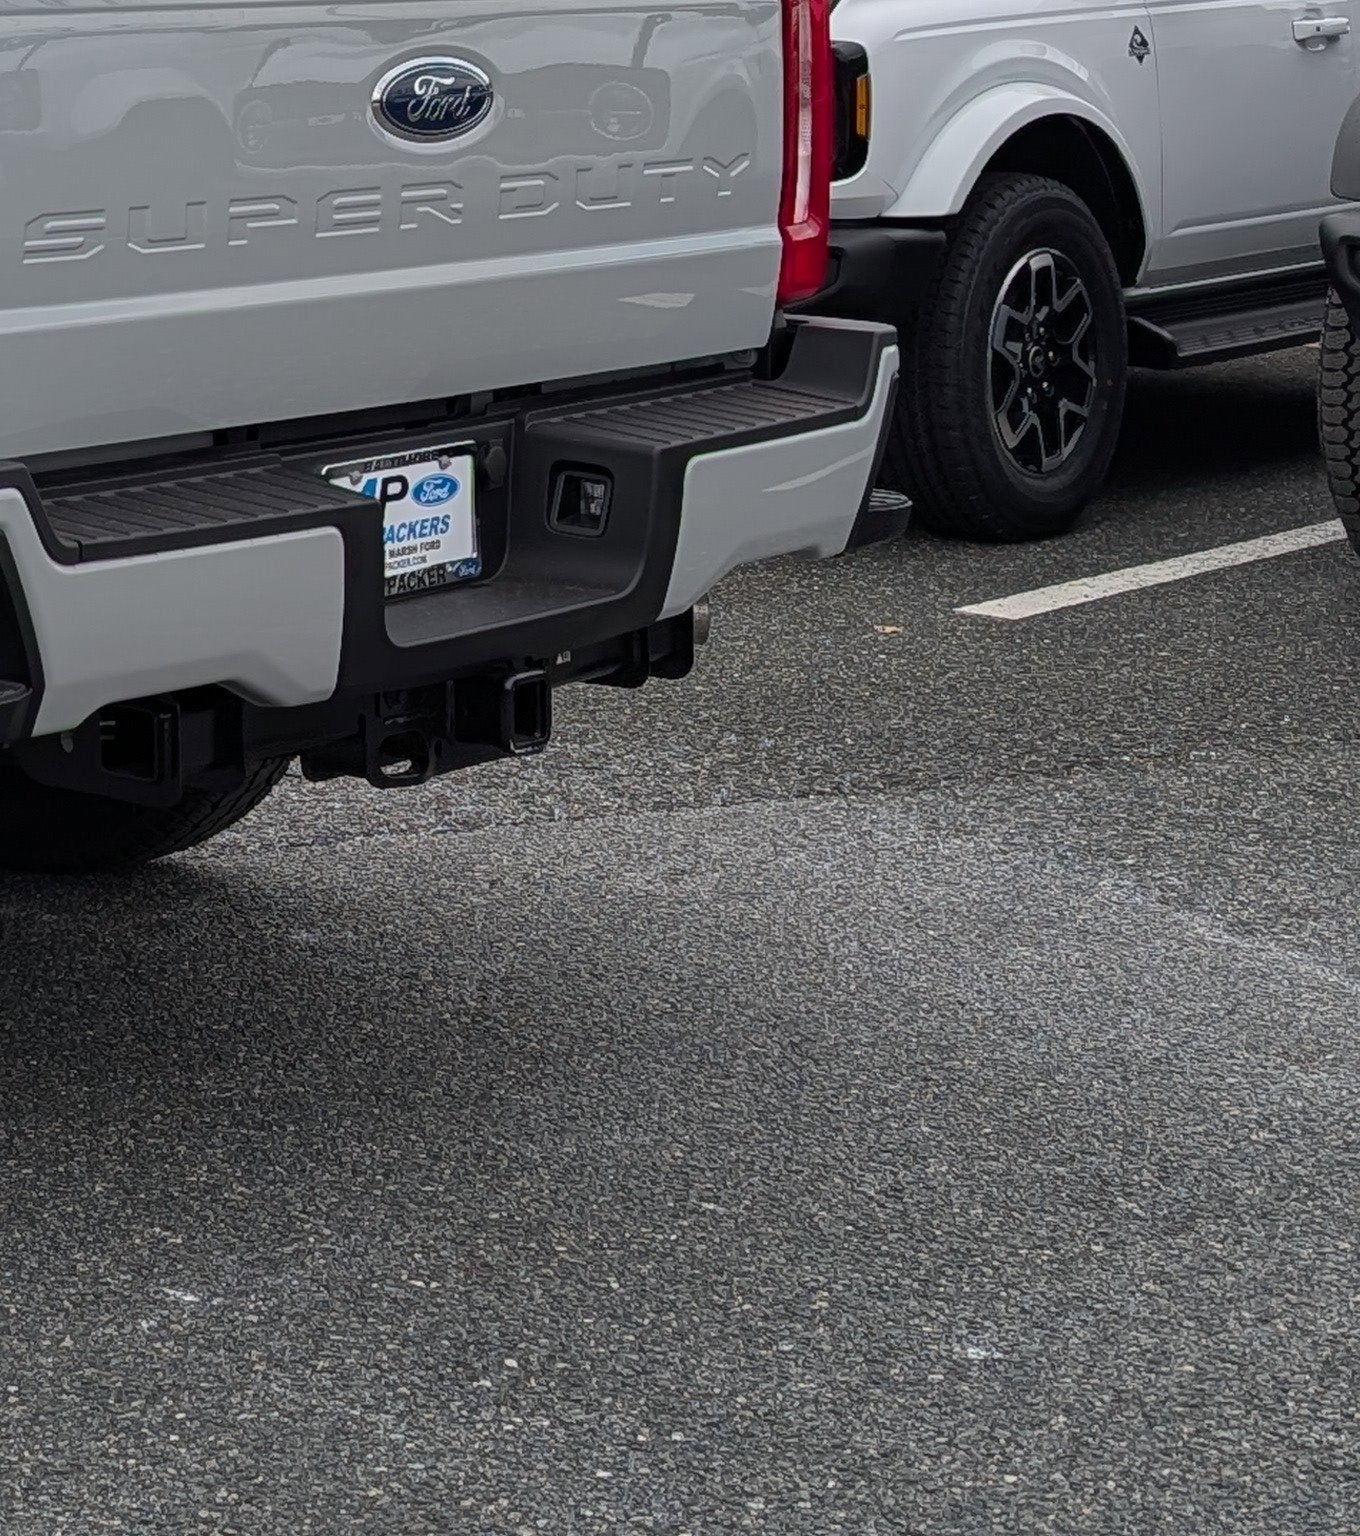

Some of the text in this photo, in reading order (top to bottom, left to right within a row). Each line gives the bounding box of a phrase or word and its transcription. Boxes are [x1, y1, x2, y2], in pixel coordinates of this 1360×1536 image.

[407, 75, 471, 123] Ford
[23, 152, 751, 264] SUPER DUTY
[419, 478, 451, 503] Ford
[384, 514, 451, 543] ACKERS
[386, 565, 447, 594] PACKER
